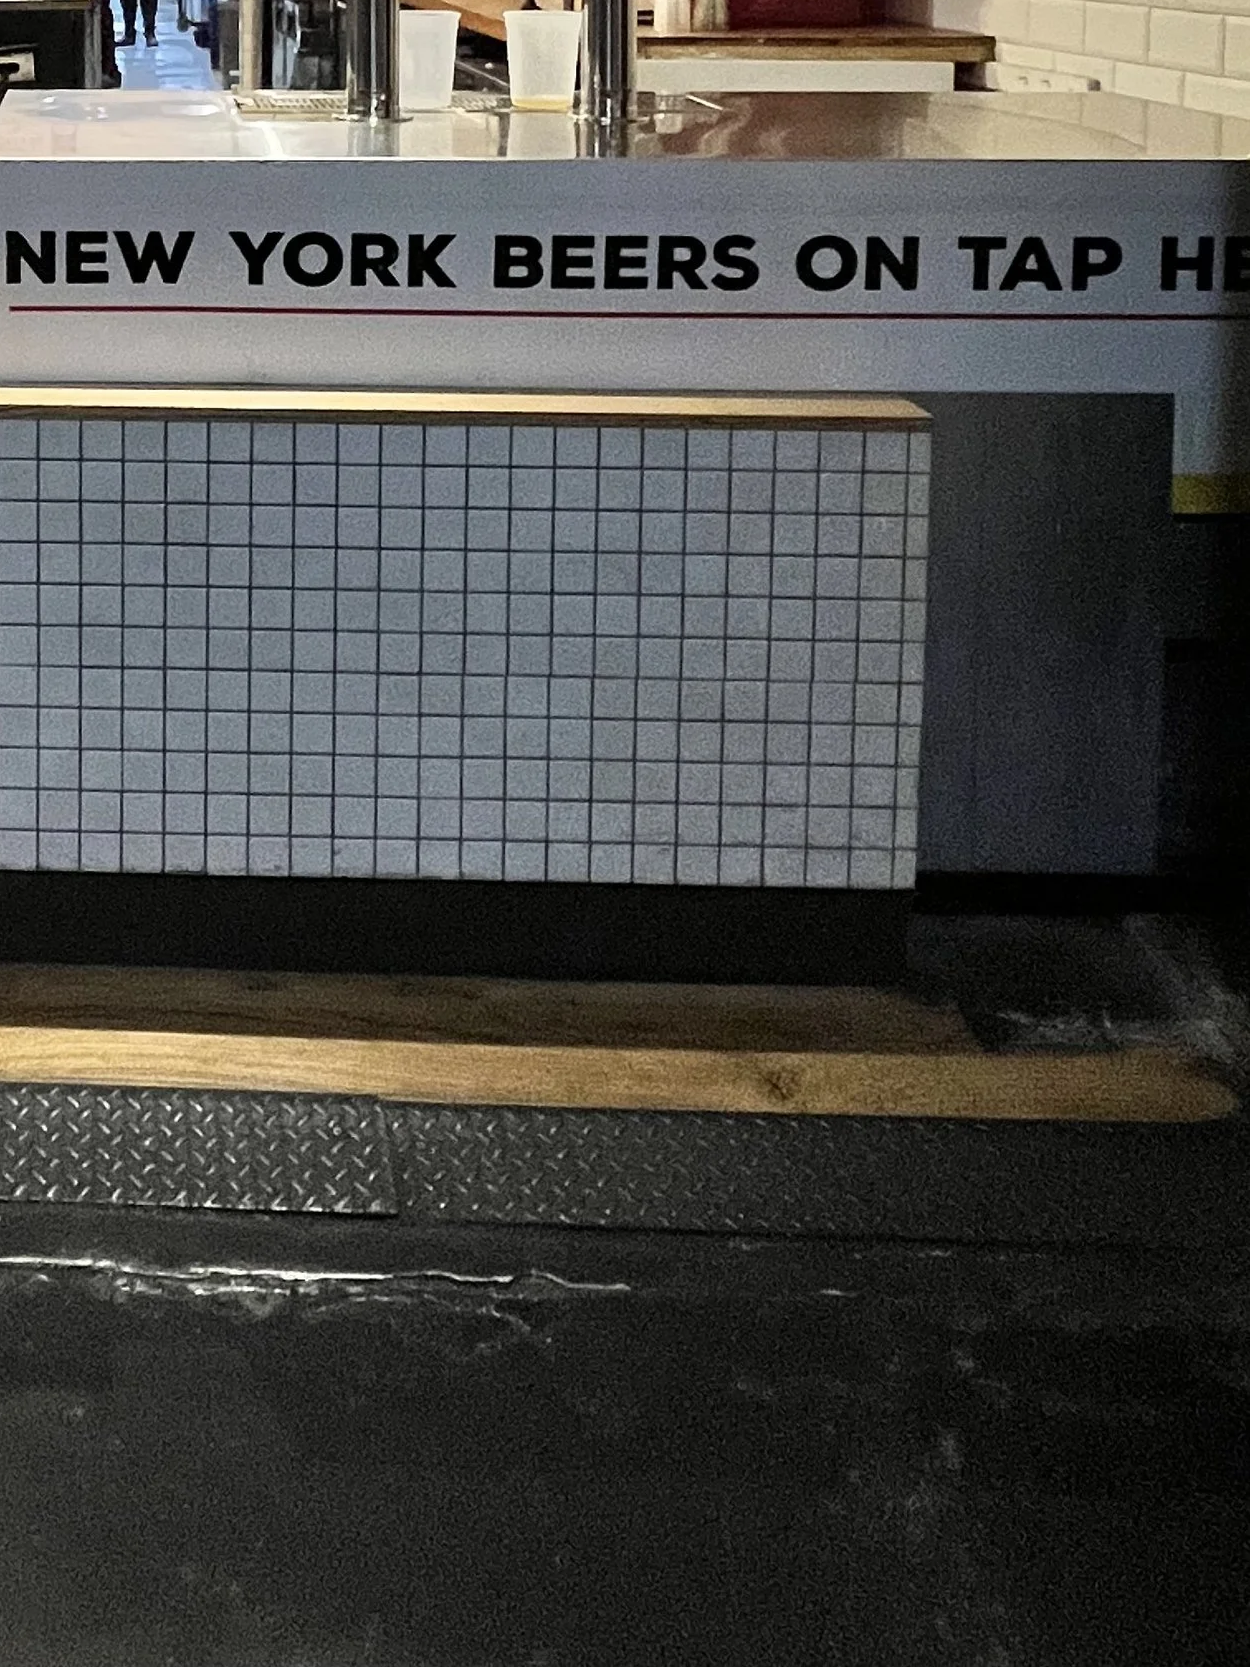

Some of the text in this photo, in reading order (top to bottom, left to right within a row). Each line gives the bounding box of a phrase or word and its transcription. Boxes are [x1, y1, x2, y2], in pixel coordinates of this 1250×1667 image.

[5, 230, 1250, 292] NEW YORK BEERS ON TAP HE
